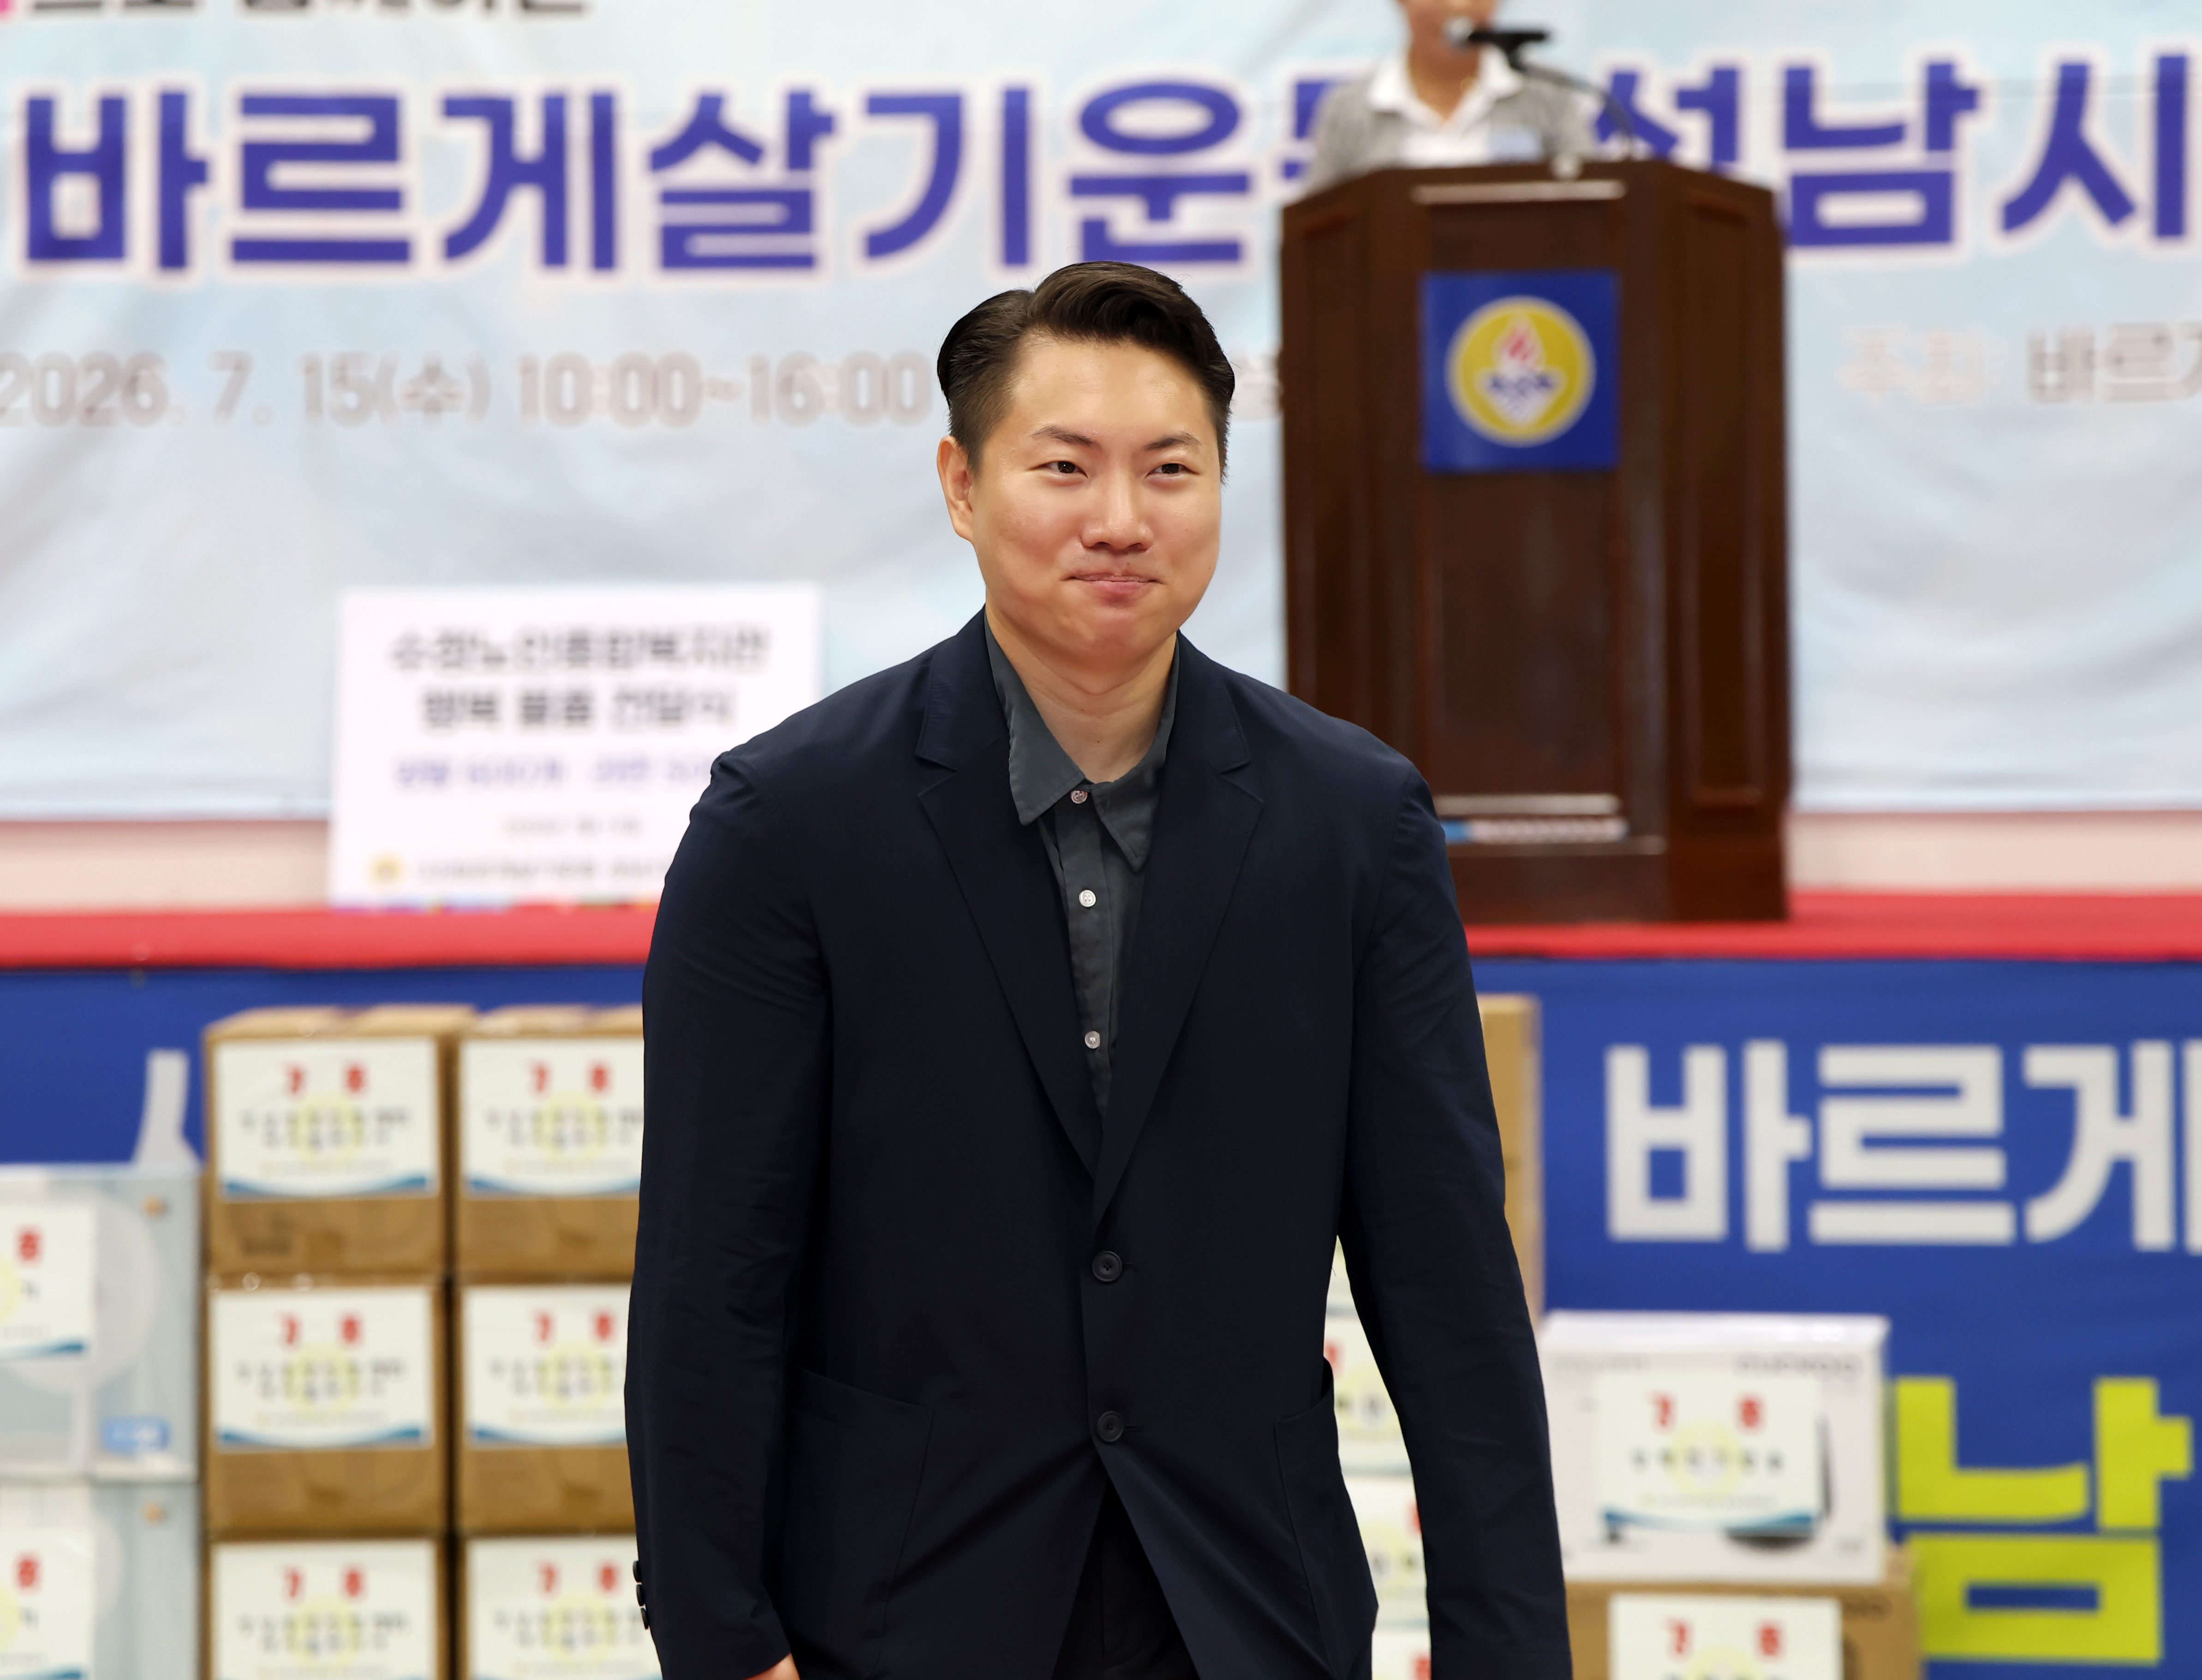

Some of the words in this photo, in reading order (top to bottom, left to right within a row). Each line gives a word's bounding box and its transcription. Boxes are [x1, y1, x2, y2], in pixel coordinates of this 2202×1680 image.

[27, 80, 1329, 271] 바르게살기운
[208, 350, 273, 428] 7.
[1605, 1039, 2202, 1254] 바르게
[1894, 1376, 2192, 1666] 남
